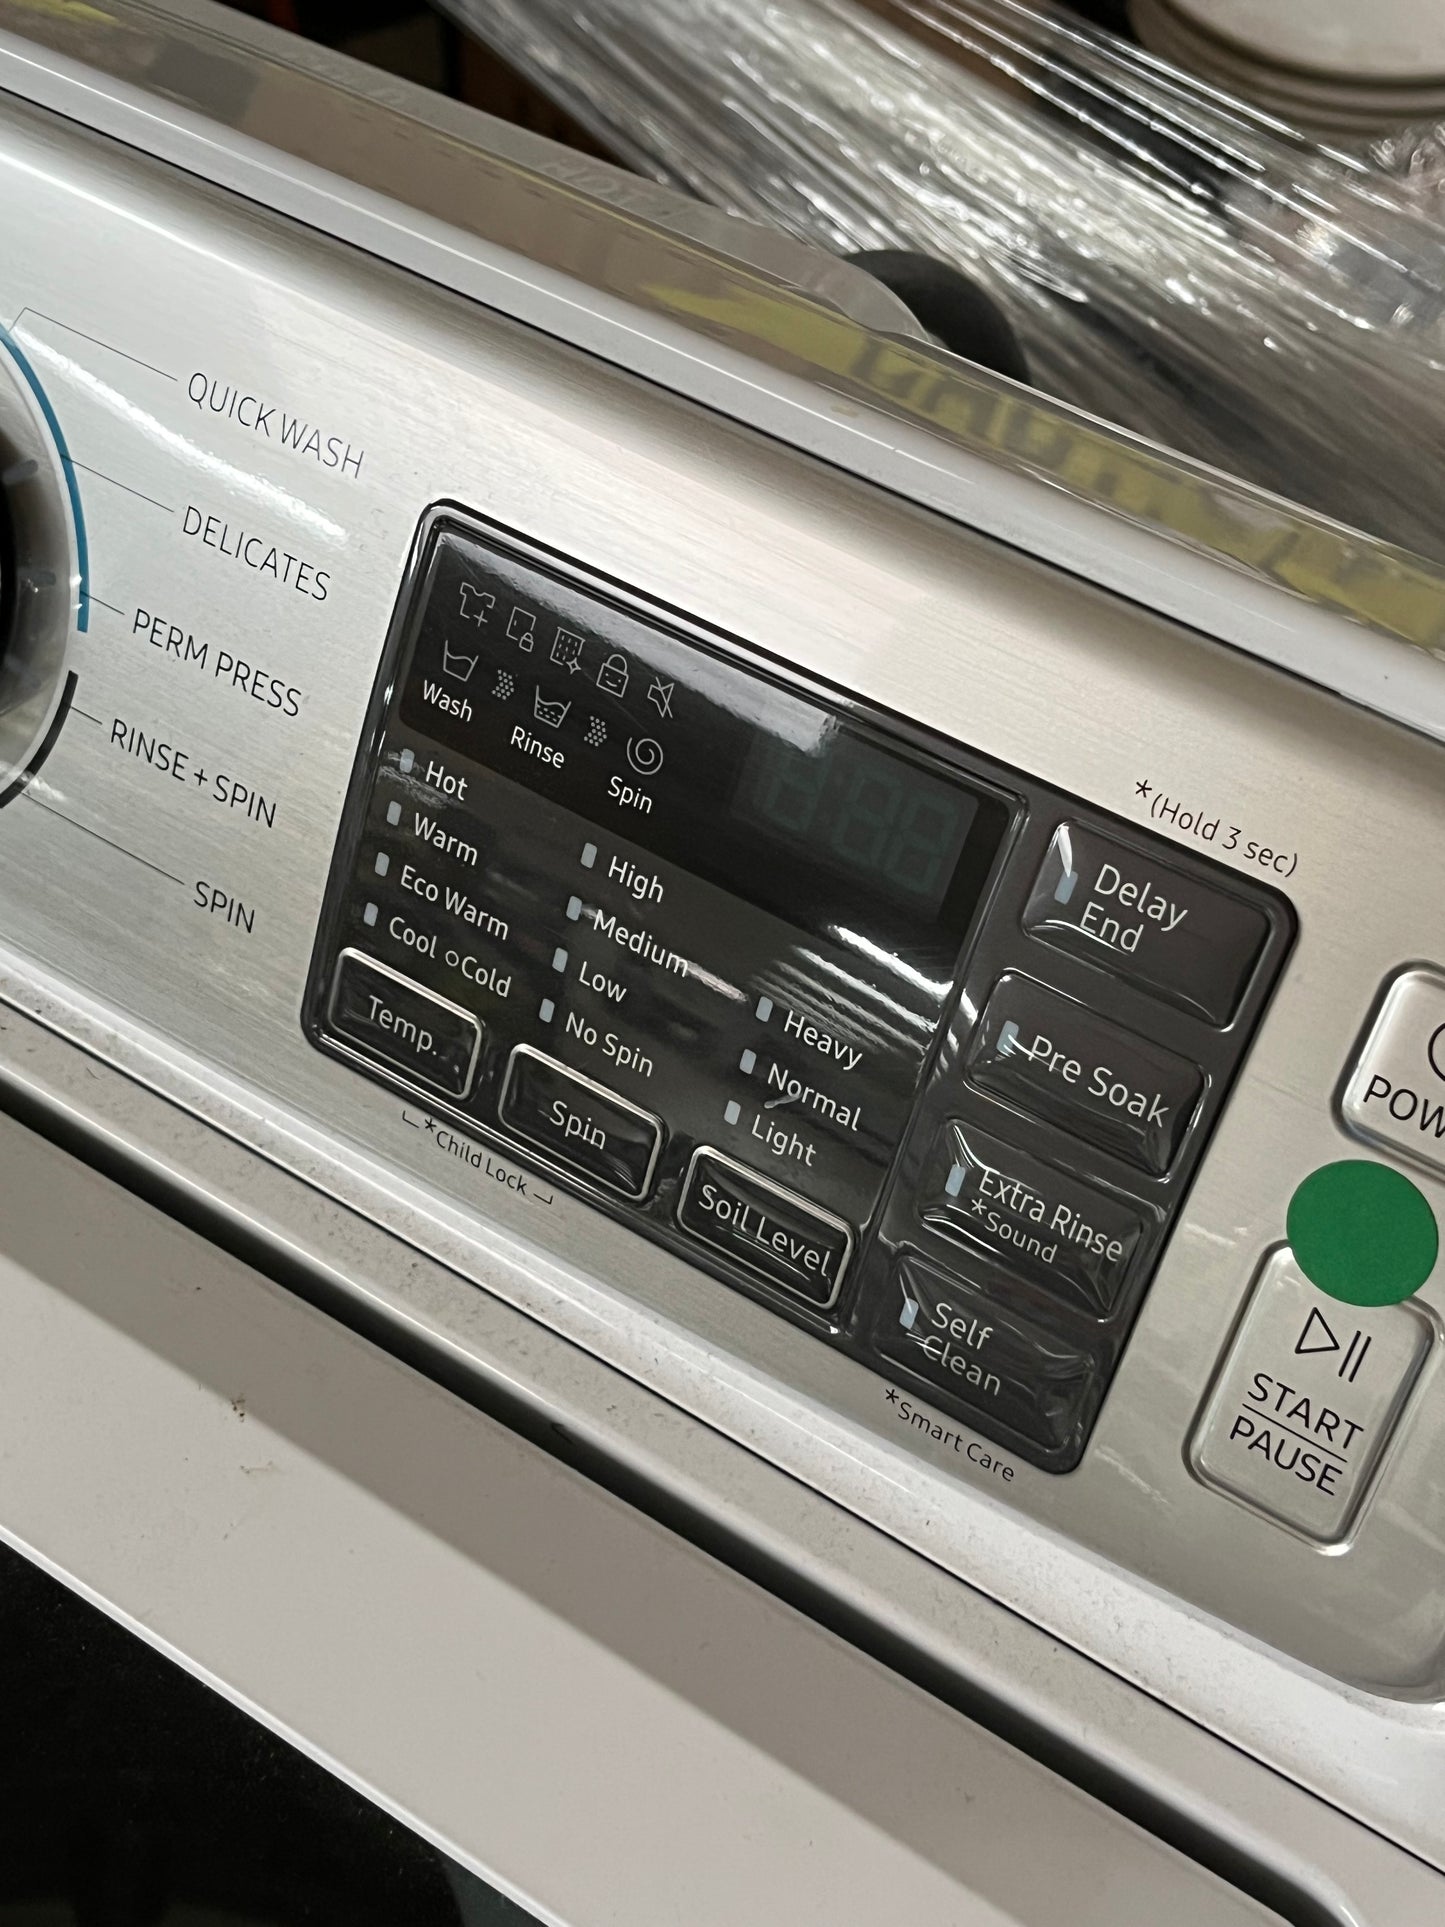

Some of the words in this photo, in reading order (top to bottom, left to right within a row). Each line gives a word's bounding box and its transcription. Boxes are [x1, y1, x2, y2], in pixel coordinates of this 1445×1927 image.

[188, 372, 275, 436] QUICK
[281, 412, 365, 479] WASH
[182, 506, 330, 601] DELICATES
[133, 609, 208, 669] PERM
[216, 652, 302, 718] PRESS
[423, 680, 473, 722] Wash
[112, 719, 188, 780] RINSE
[213, 775, 277, 828] SPIN
[511, 726, 565, 769] Rinse
[425, 761, 468, 801] Hot
[608, 776, 653, 814] Spin
[415, 813, 478, 865] Warm
[1222, 826, 1242, 850] 3
[1243, 840, 1299, 878] sec)
[194, 882, 256, 934] SPIN
[400, 865, 438, 902] Eco
[446, 887, 509, 940] Warm
[608, 856, 664, 903] High
[1093, 863, 1189, 932] Delay
[389, 916, 436, 958] Cool
[593, 909, 688, 978] Medium
[1080, 901, 1144, 952] End
[579, 961, 627, 1003] Low
[368, 995, 438, 1056] Temp.
[566, 1012, 597, 1046] No
[602, 1034, 653, 1078] Spin
[783, 1010, 863, 1071] Heavy
[768, 1063, 861, 1131] Normal
[1029, 1035, 1081, 1083] Pre
[1089, 1067, 1169, 1128] Soak
[551, 1101, 607, 1150] Spin
[751, 1114, 817, 1167] Light
[486, 1158, 527, 1196] Lock
[698, 1184, 746, 1233] Soil
[756, 1215, 831, 1277] Level
[979, 1169, 1045, 1222] Extra
[1051, 1204, 1124, 1262] Rinse
[932, 1302, 993, 1352] Self
[922, 1335, 1001, 1396] Clean
[1247, 1373, 1364, 1449] START
[967, 1442, 1015, 1482] Care
[1229, 1415, 1343, 1497] PAUSE
